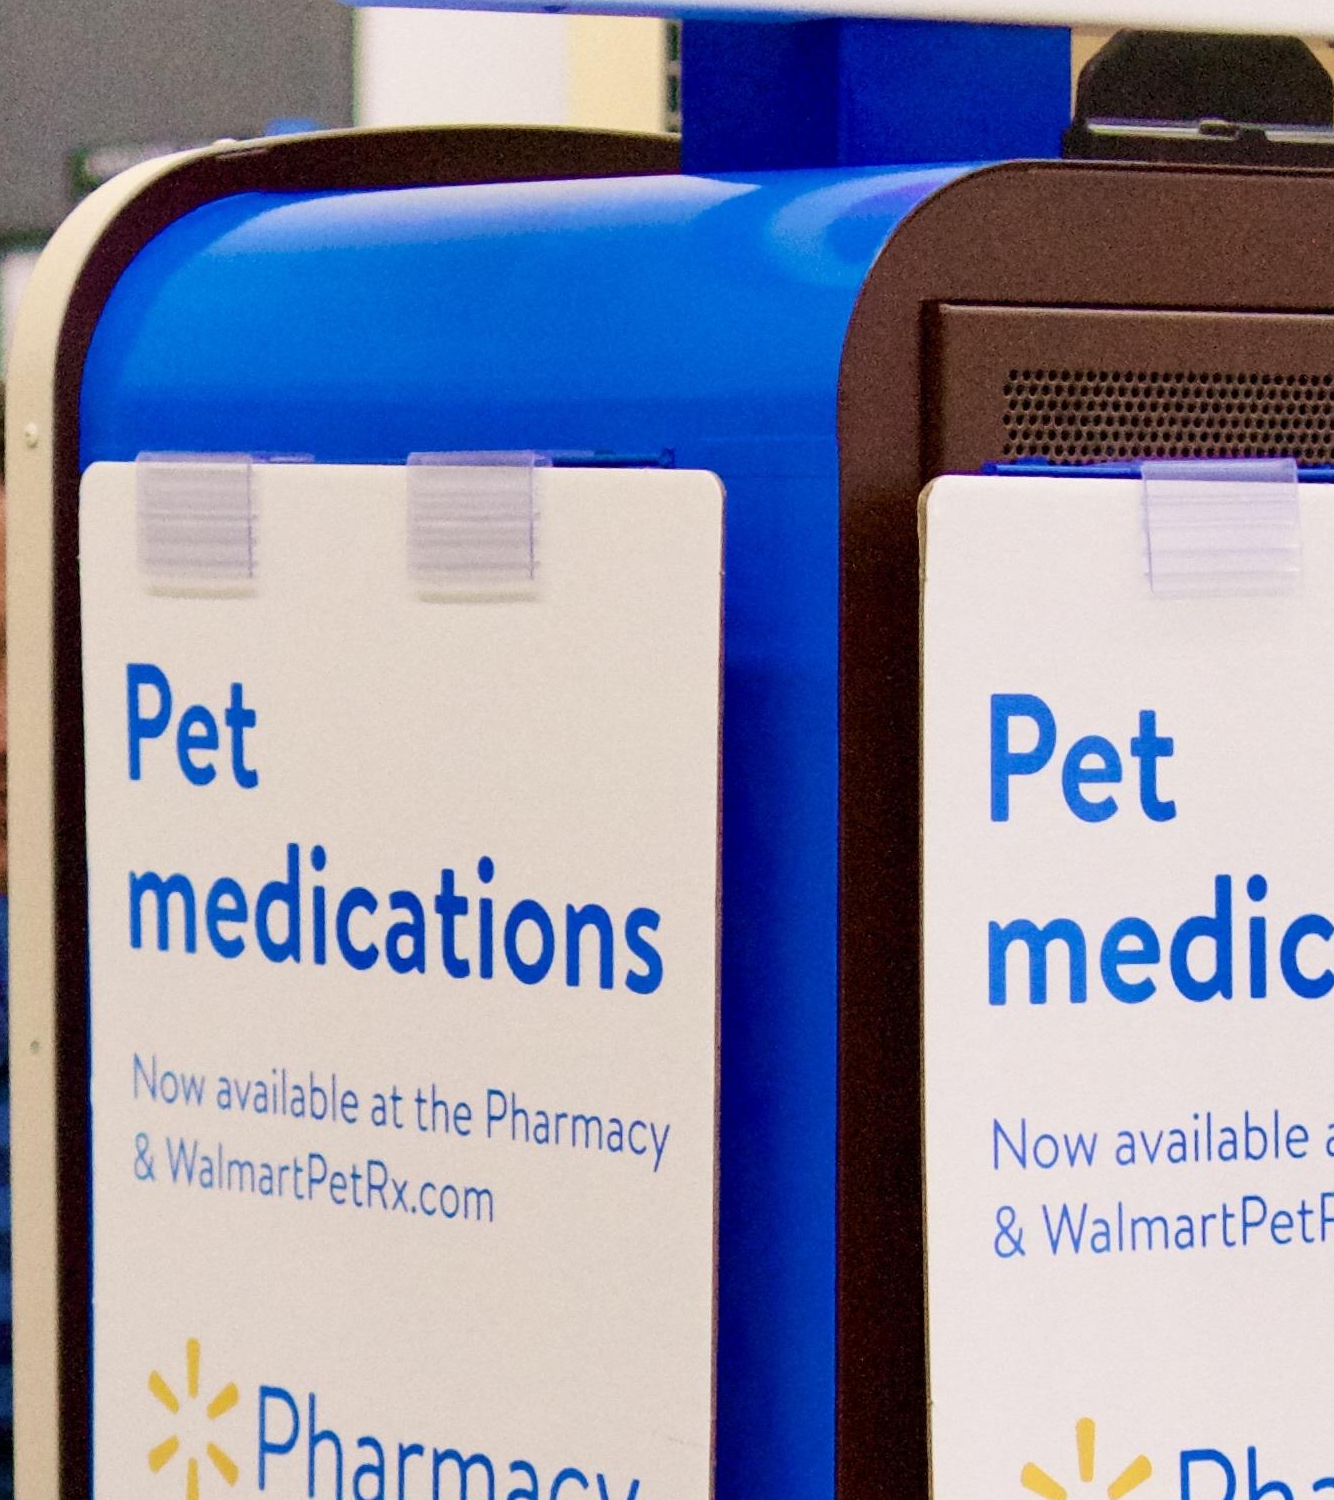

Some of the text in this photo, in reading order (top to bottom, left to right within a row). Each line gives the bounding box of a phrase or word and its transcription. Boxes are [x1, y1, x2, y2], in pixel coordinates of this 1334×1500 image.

[126, 662, 258, 789] Pet
[989, 693, 1177, 824] Pet
[128, 843, 664, 995] medications
[133, 1052, 671, 1173] Now available at the Pharmacy
[992, 1117, 1098, 1171] Now
[1115, 1109, 1308, 1165] available
[133, 1132, 495, 1223] & WalmartPetRx.com
[994, 1206, 1026, 1259] &
